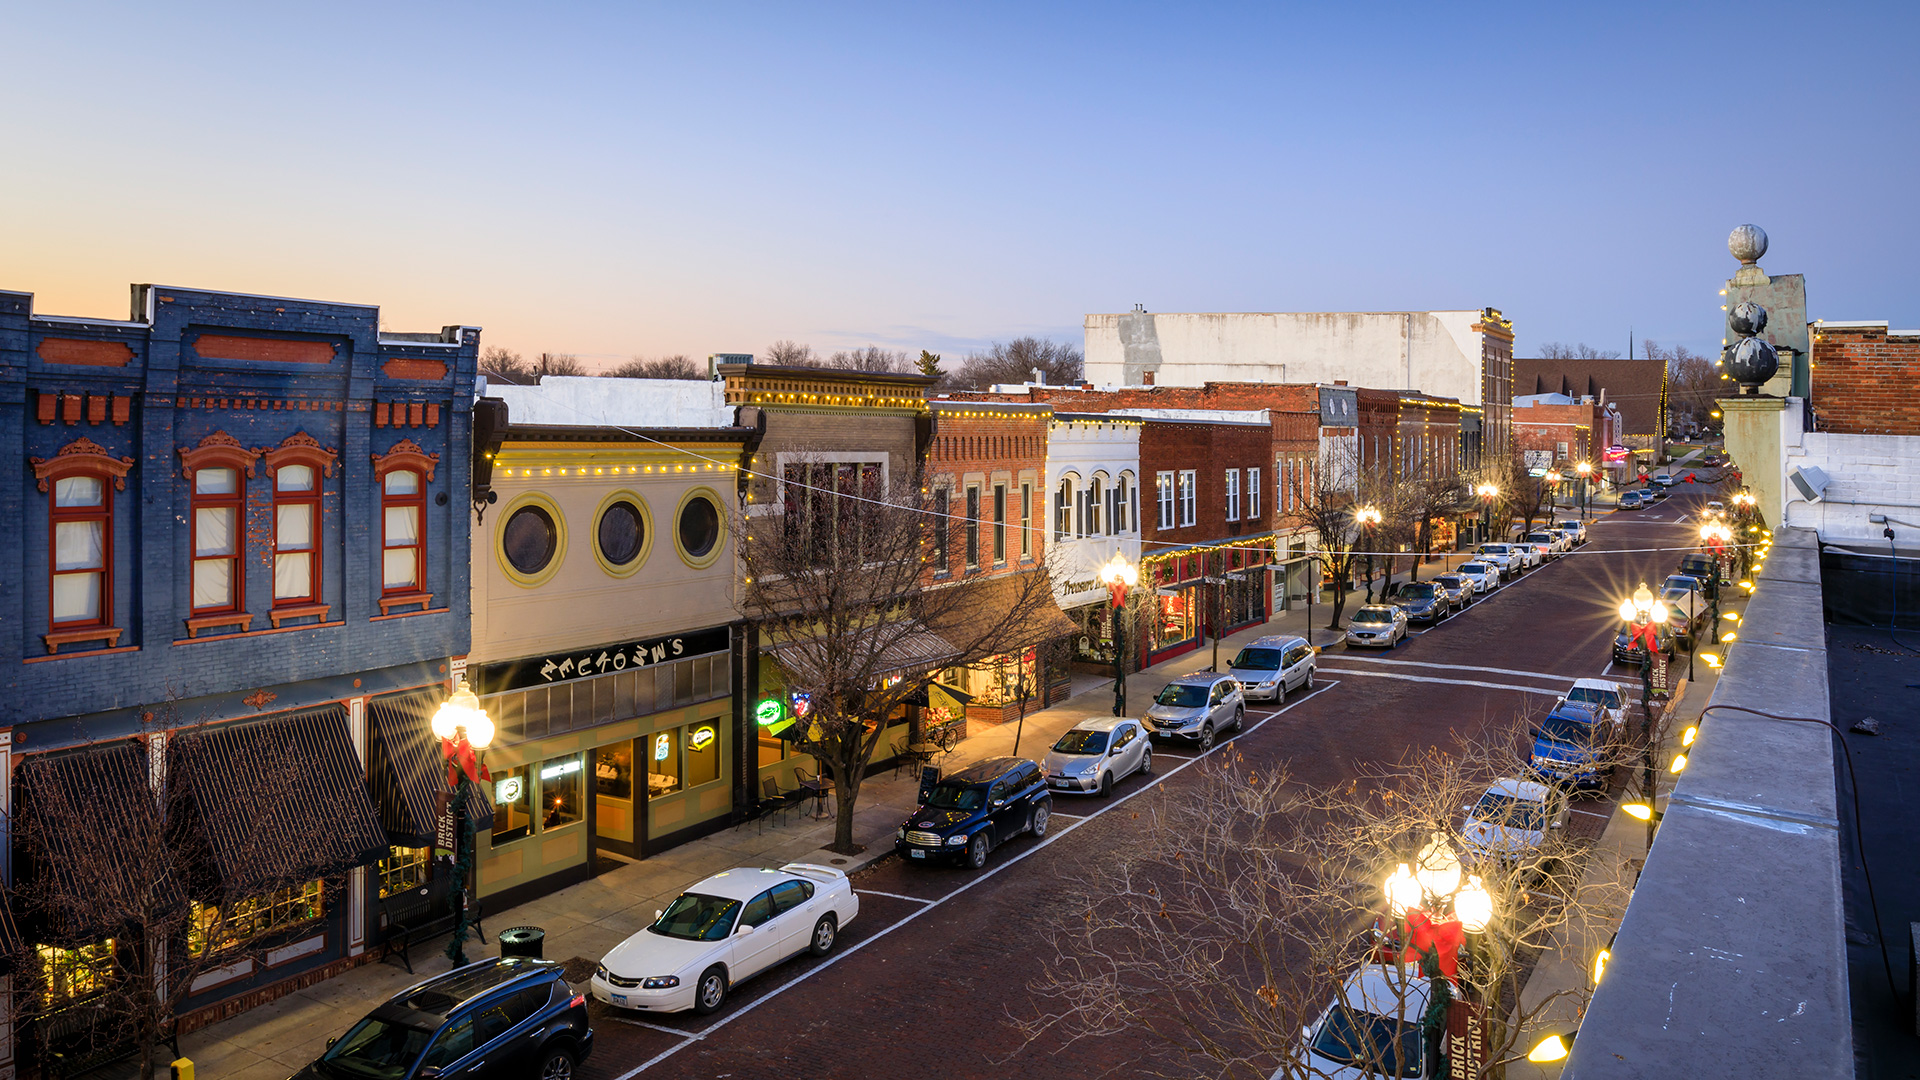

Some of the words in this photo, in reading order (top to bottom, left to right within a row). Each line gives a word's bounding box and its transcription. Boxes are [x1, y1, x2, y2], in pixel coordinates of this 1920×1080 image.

[437, 815, 446, 847] BRICK
[445, 801, 454, 849] DISTRICT
[1451, 1033, 1466, 1080] BRICK
